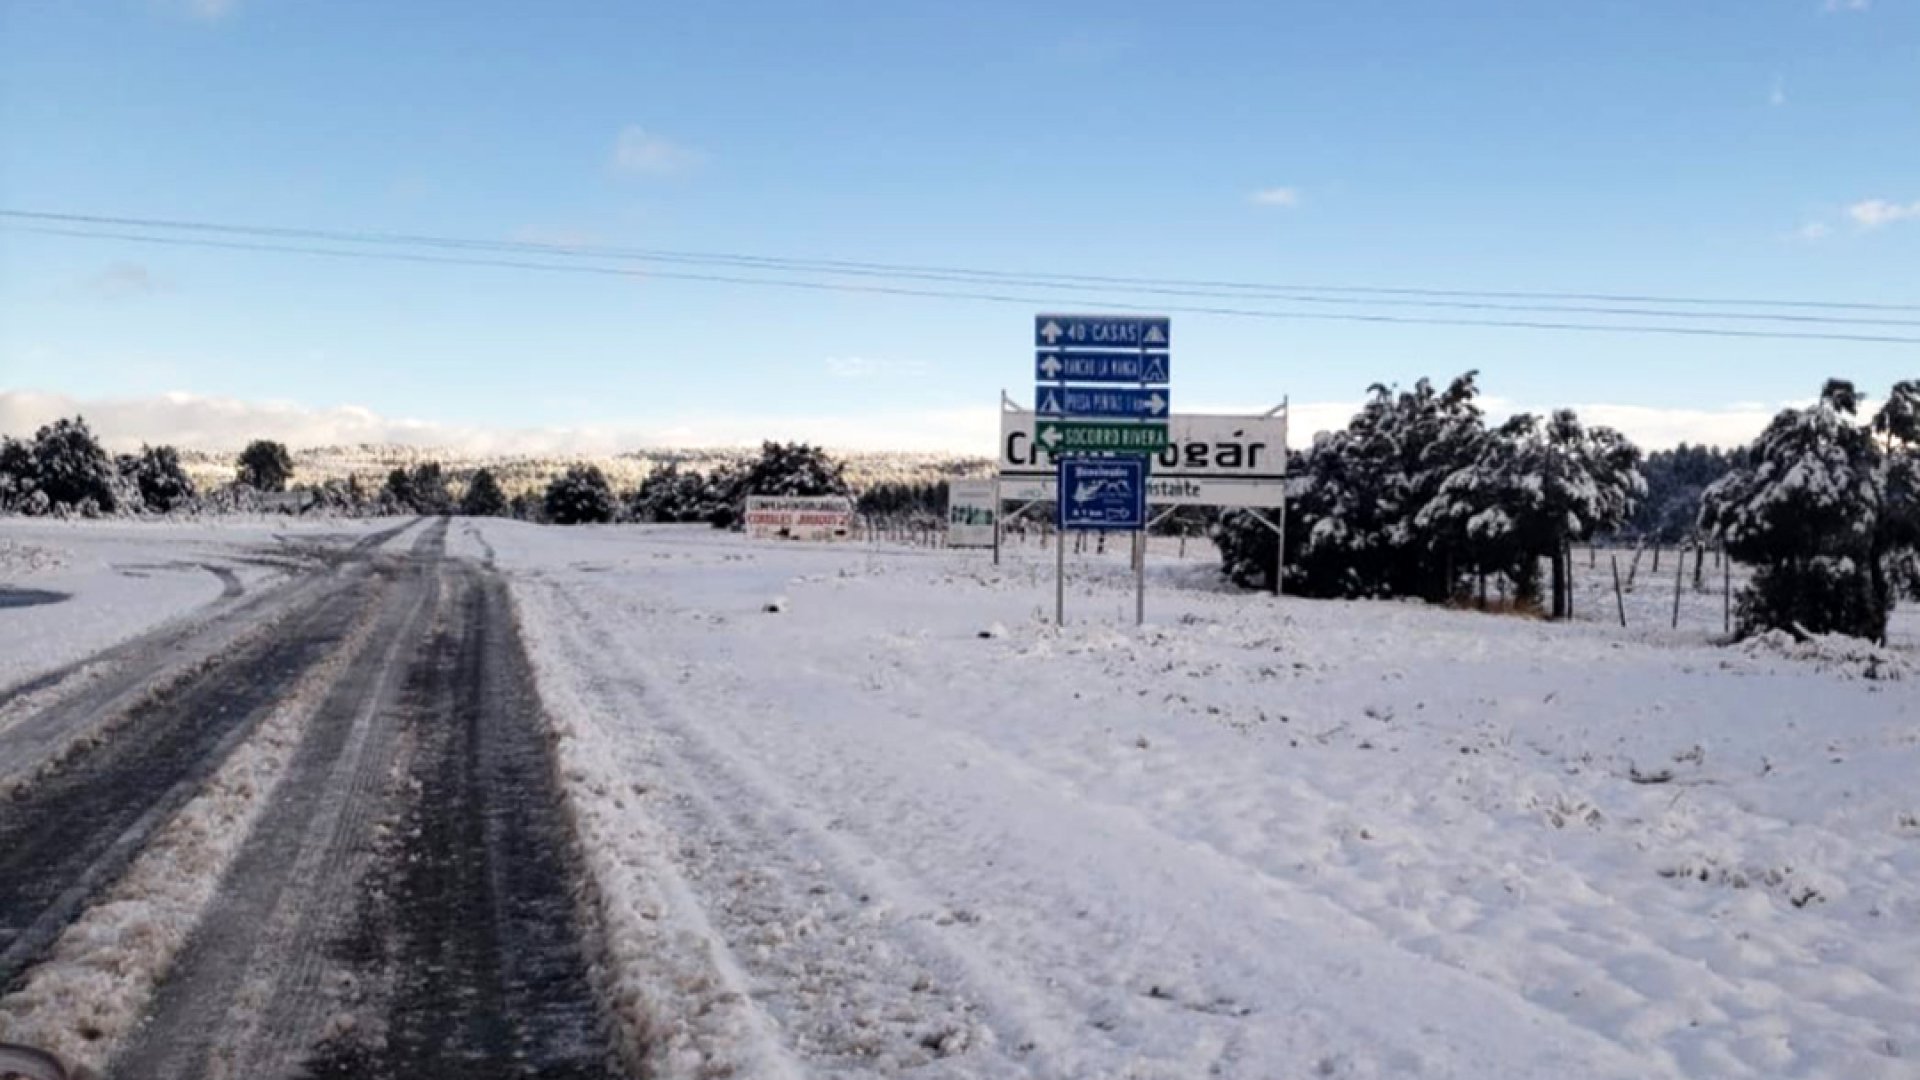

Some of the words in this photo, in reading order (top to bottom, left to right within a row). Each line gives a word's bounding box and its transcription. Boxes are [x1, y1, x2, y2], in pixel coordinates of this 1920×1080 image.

[1067, 323, 1086, 342] 40
[1091, 324, 1138, 342] CASAS
[1065, 427, 1120, 445] SOCORRO
[1121, 429, 1164, 446] RIVERA
